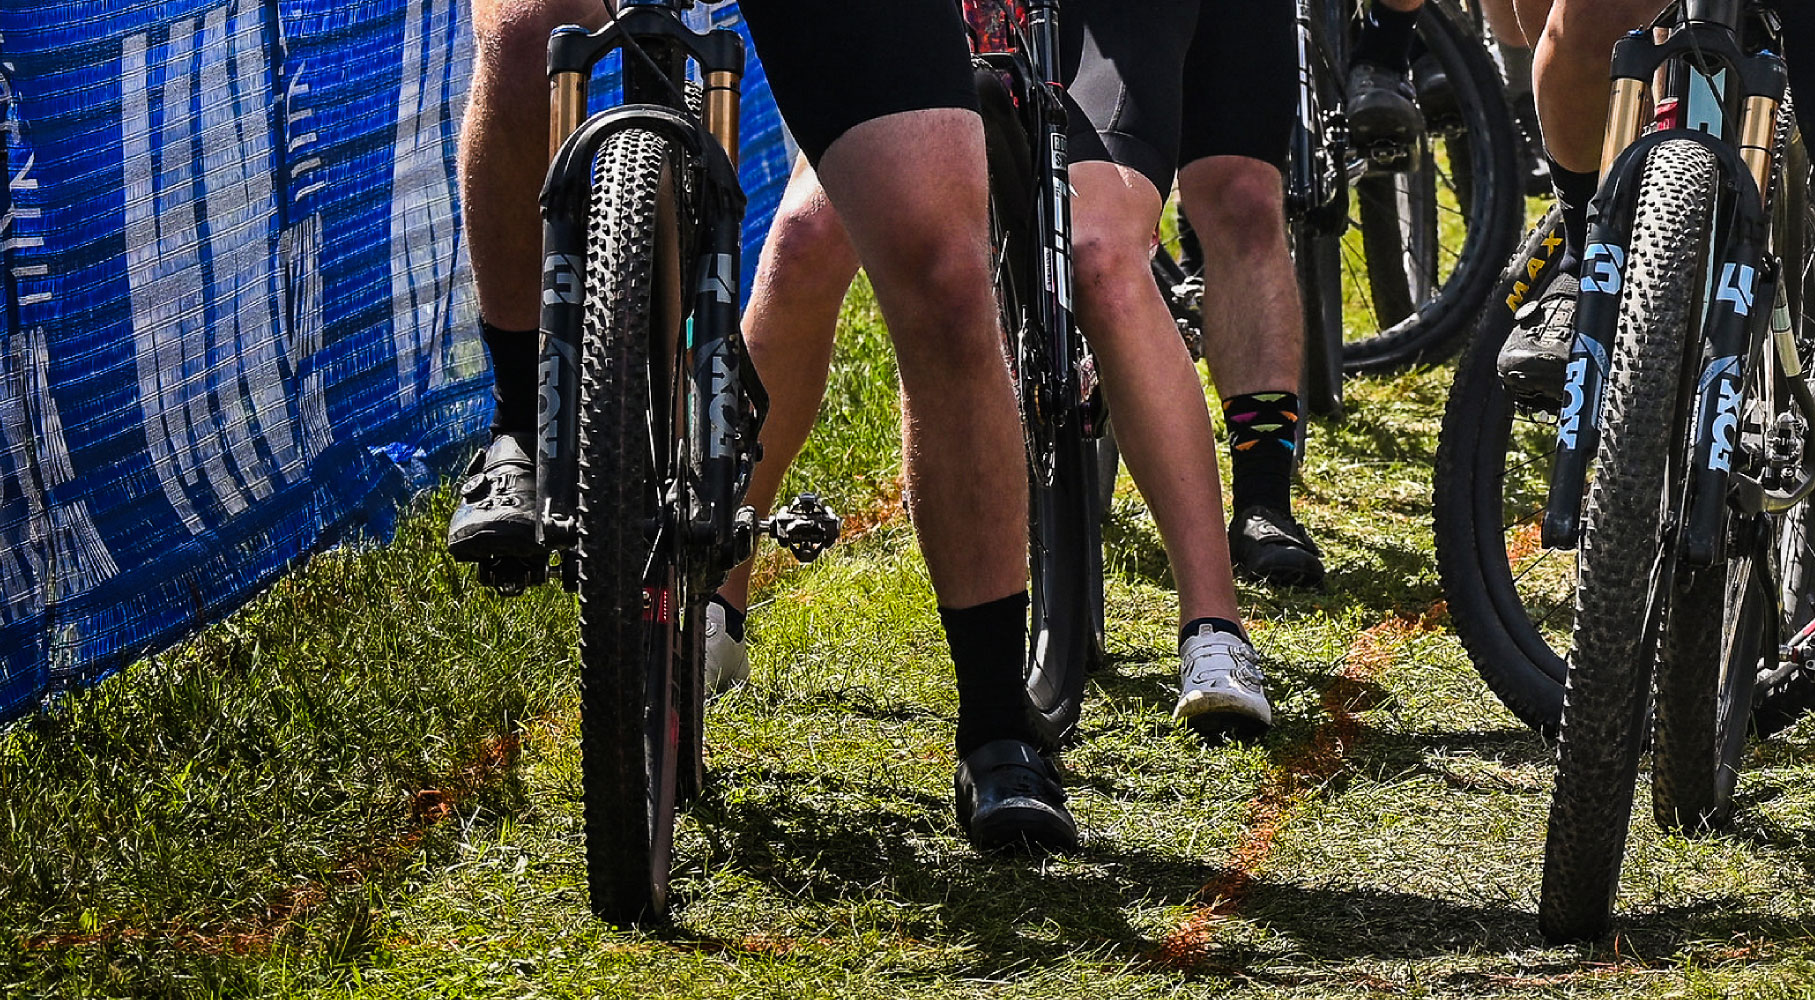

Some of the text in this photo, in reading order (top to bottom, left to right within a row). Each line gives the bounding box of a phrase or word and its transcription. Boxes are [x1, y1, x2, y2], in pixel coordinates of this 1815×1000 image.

[543, 252, 585, 306] 3
[697, 252, 737, 304] 4
[1580, 243, 1625, 296] 3
[1715, 262, 1755, 317] 4
[1556, 357, 1587, 451] FOX
[1707, 378, 1745, 475] FOX
